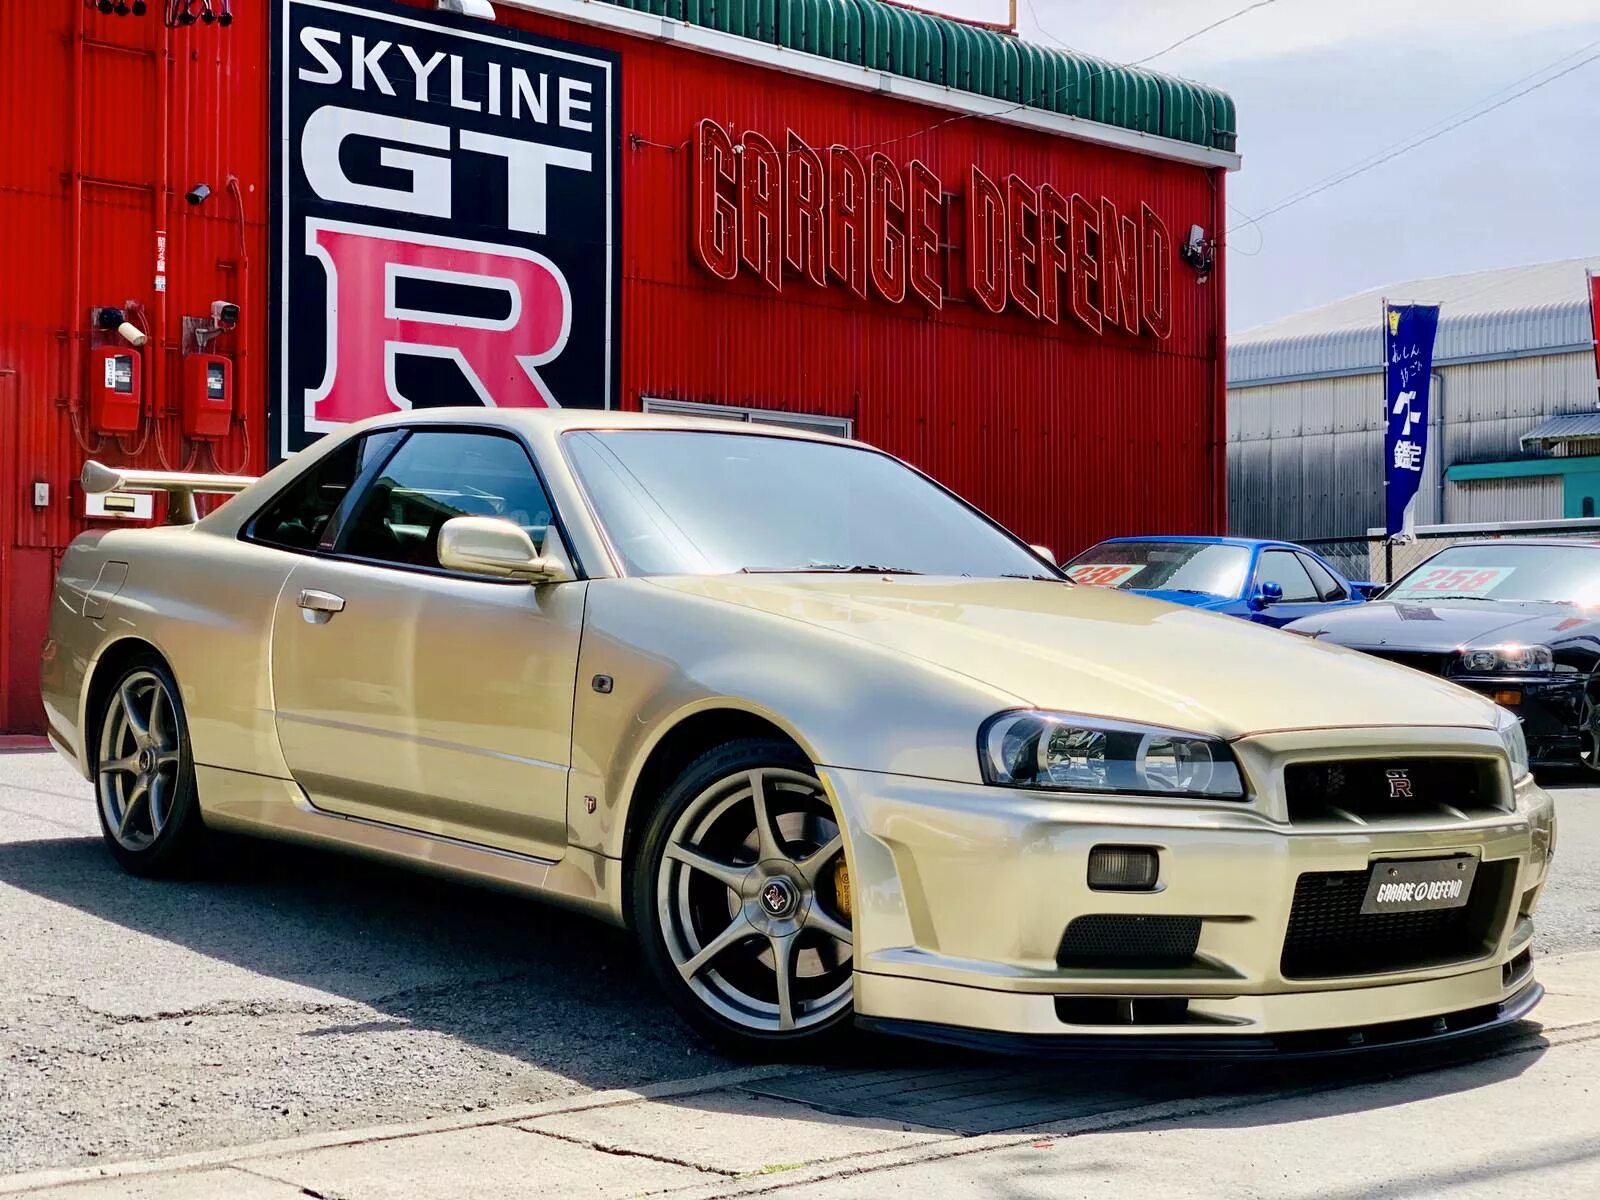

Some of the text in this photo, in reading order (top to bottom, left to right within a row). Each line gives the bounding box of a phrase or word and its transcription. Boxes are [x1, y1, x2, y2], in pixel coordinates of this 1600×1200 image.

[299, 26, 593, 132] SKYLINE
[301, 104, 592, 235] GT
[696, 117, 1172, 340] GARAGE DEFEND
[305, 216, 572, 433] R
[1409, 568, 1500, 592] 258
[1389, 778, 1413, 798] R
[1376, 879, 1463, 903] GARAGE DEFEND
